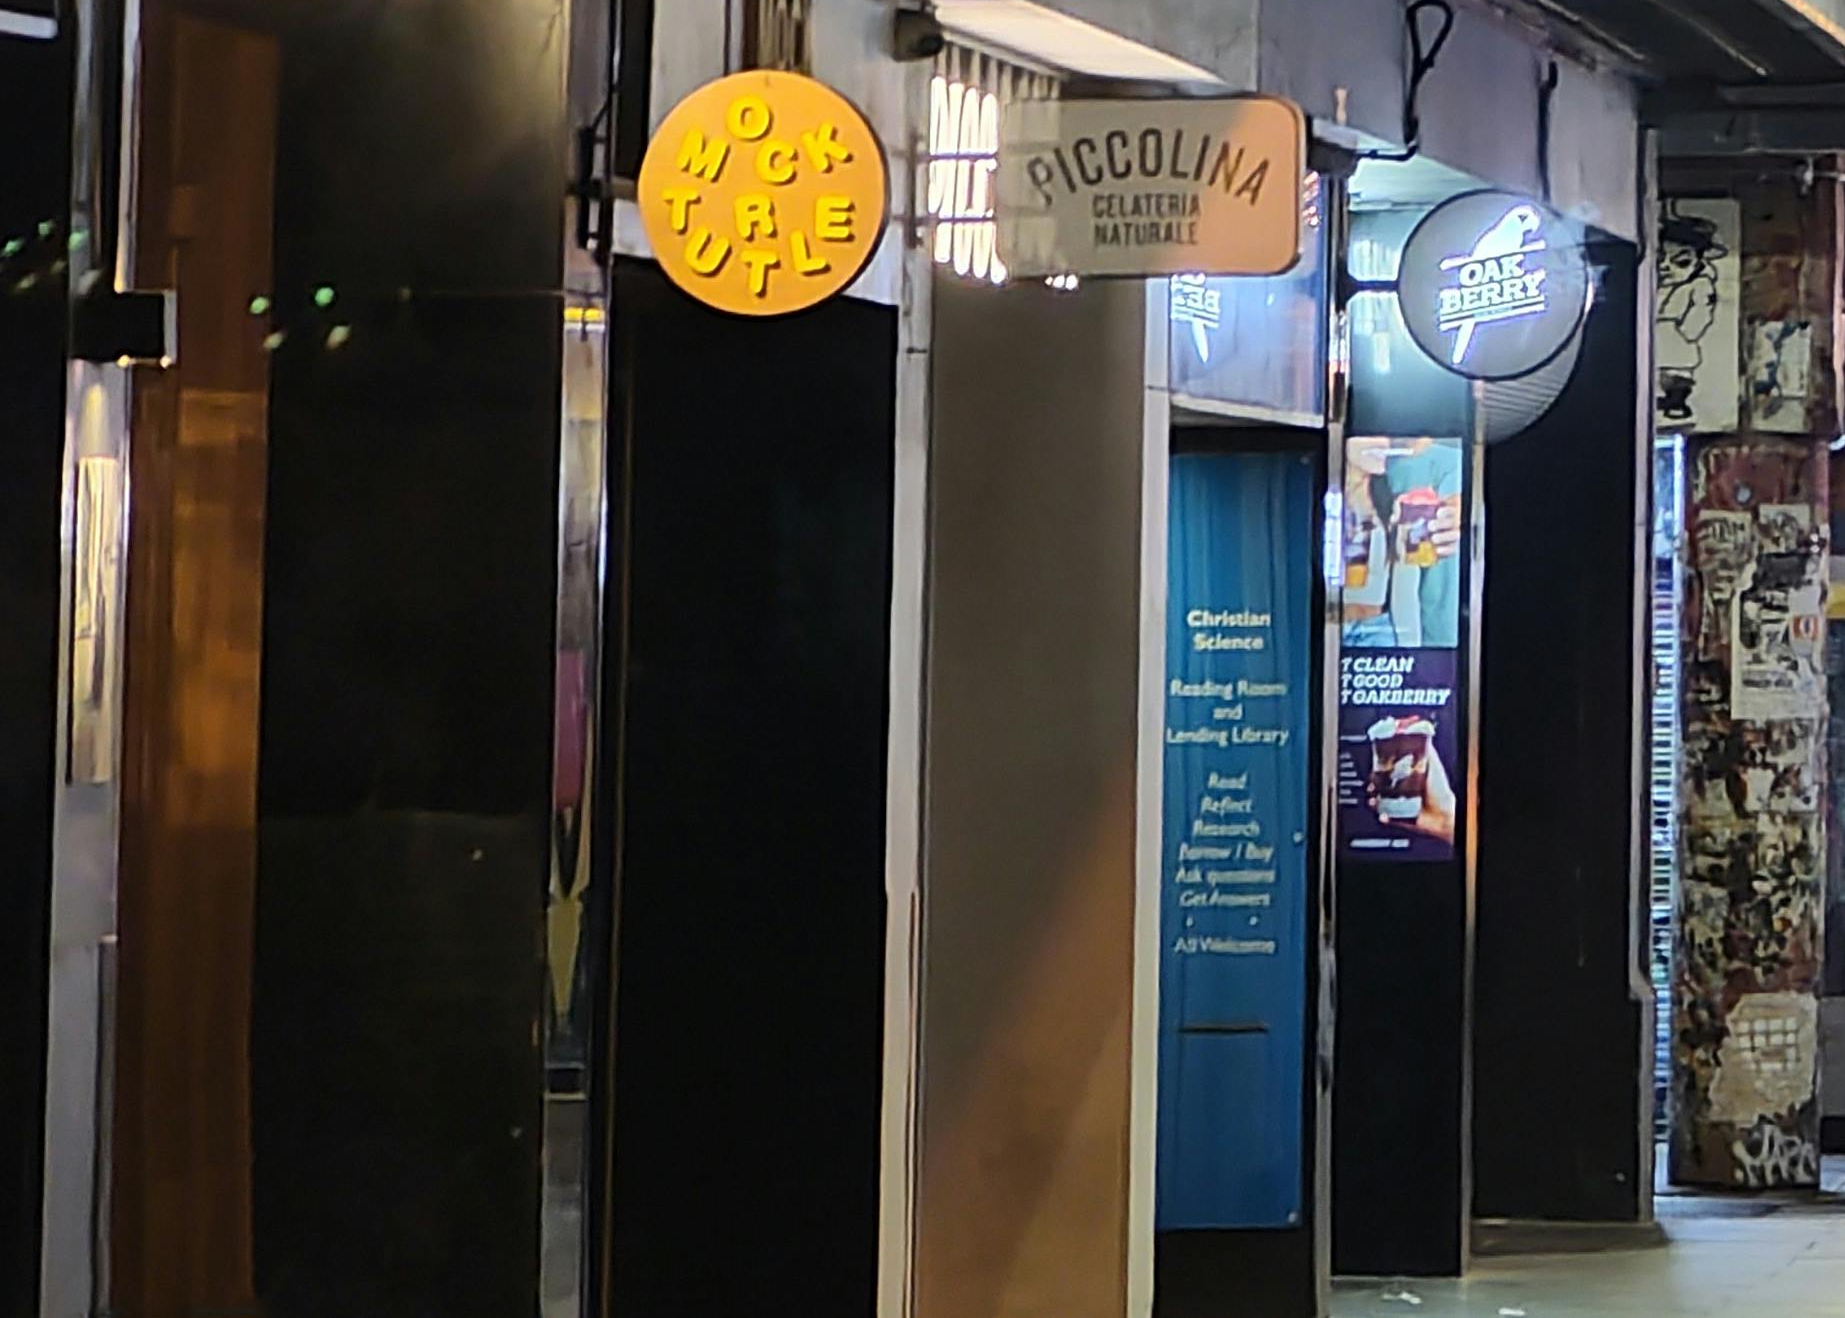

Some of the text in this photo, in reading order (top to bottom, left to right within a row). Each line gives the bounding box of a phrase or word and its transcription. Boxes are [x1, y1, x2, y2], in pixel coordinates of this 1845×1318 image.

[1026, 127, 1270, 208] PICCOLINA
[1092, 193, 1200, 218] GELATERIA
[1094, 221, 1199, 246] NATURALE
[1459, 254, 1525, 286] OAK
[1439, 268, 1546, 315] BERRY
[1187, 609, 1271, 627] Christian
[1193, 633, 1264, 650] Science
[1353, 656, 1415, 673] CLEAN
[1352, 673, 1404, 688] GOOD
[1352, 688, 1451, 705] OAKBERRY
[1213, 703, 1243, 720] and
[1232, 726, 1289, 747] Library
